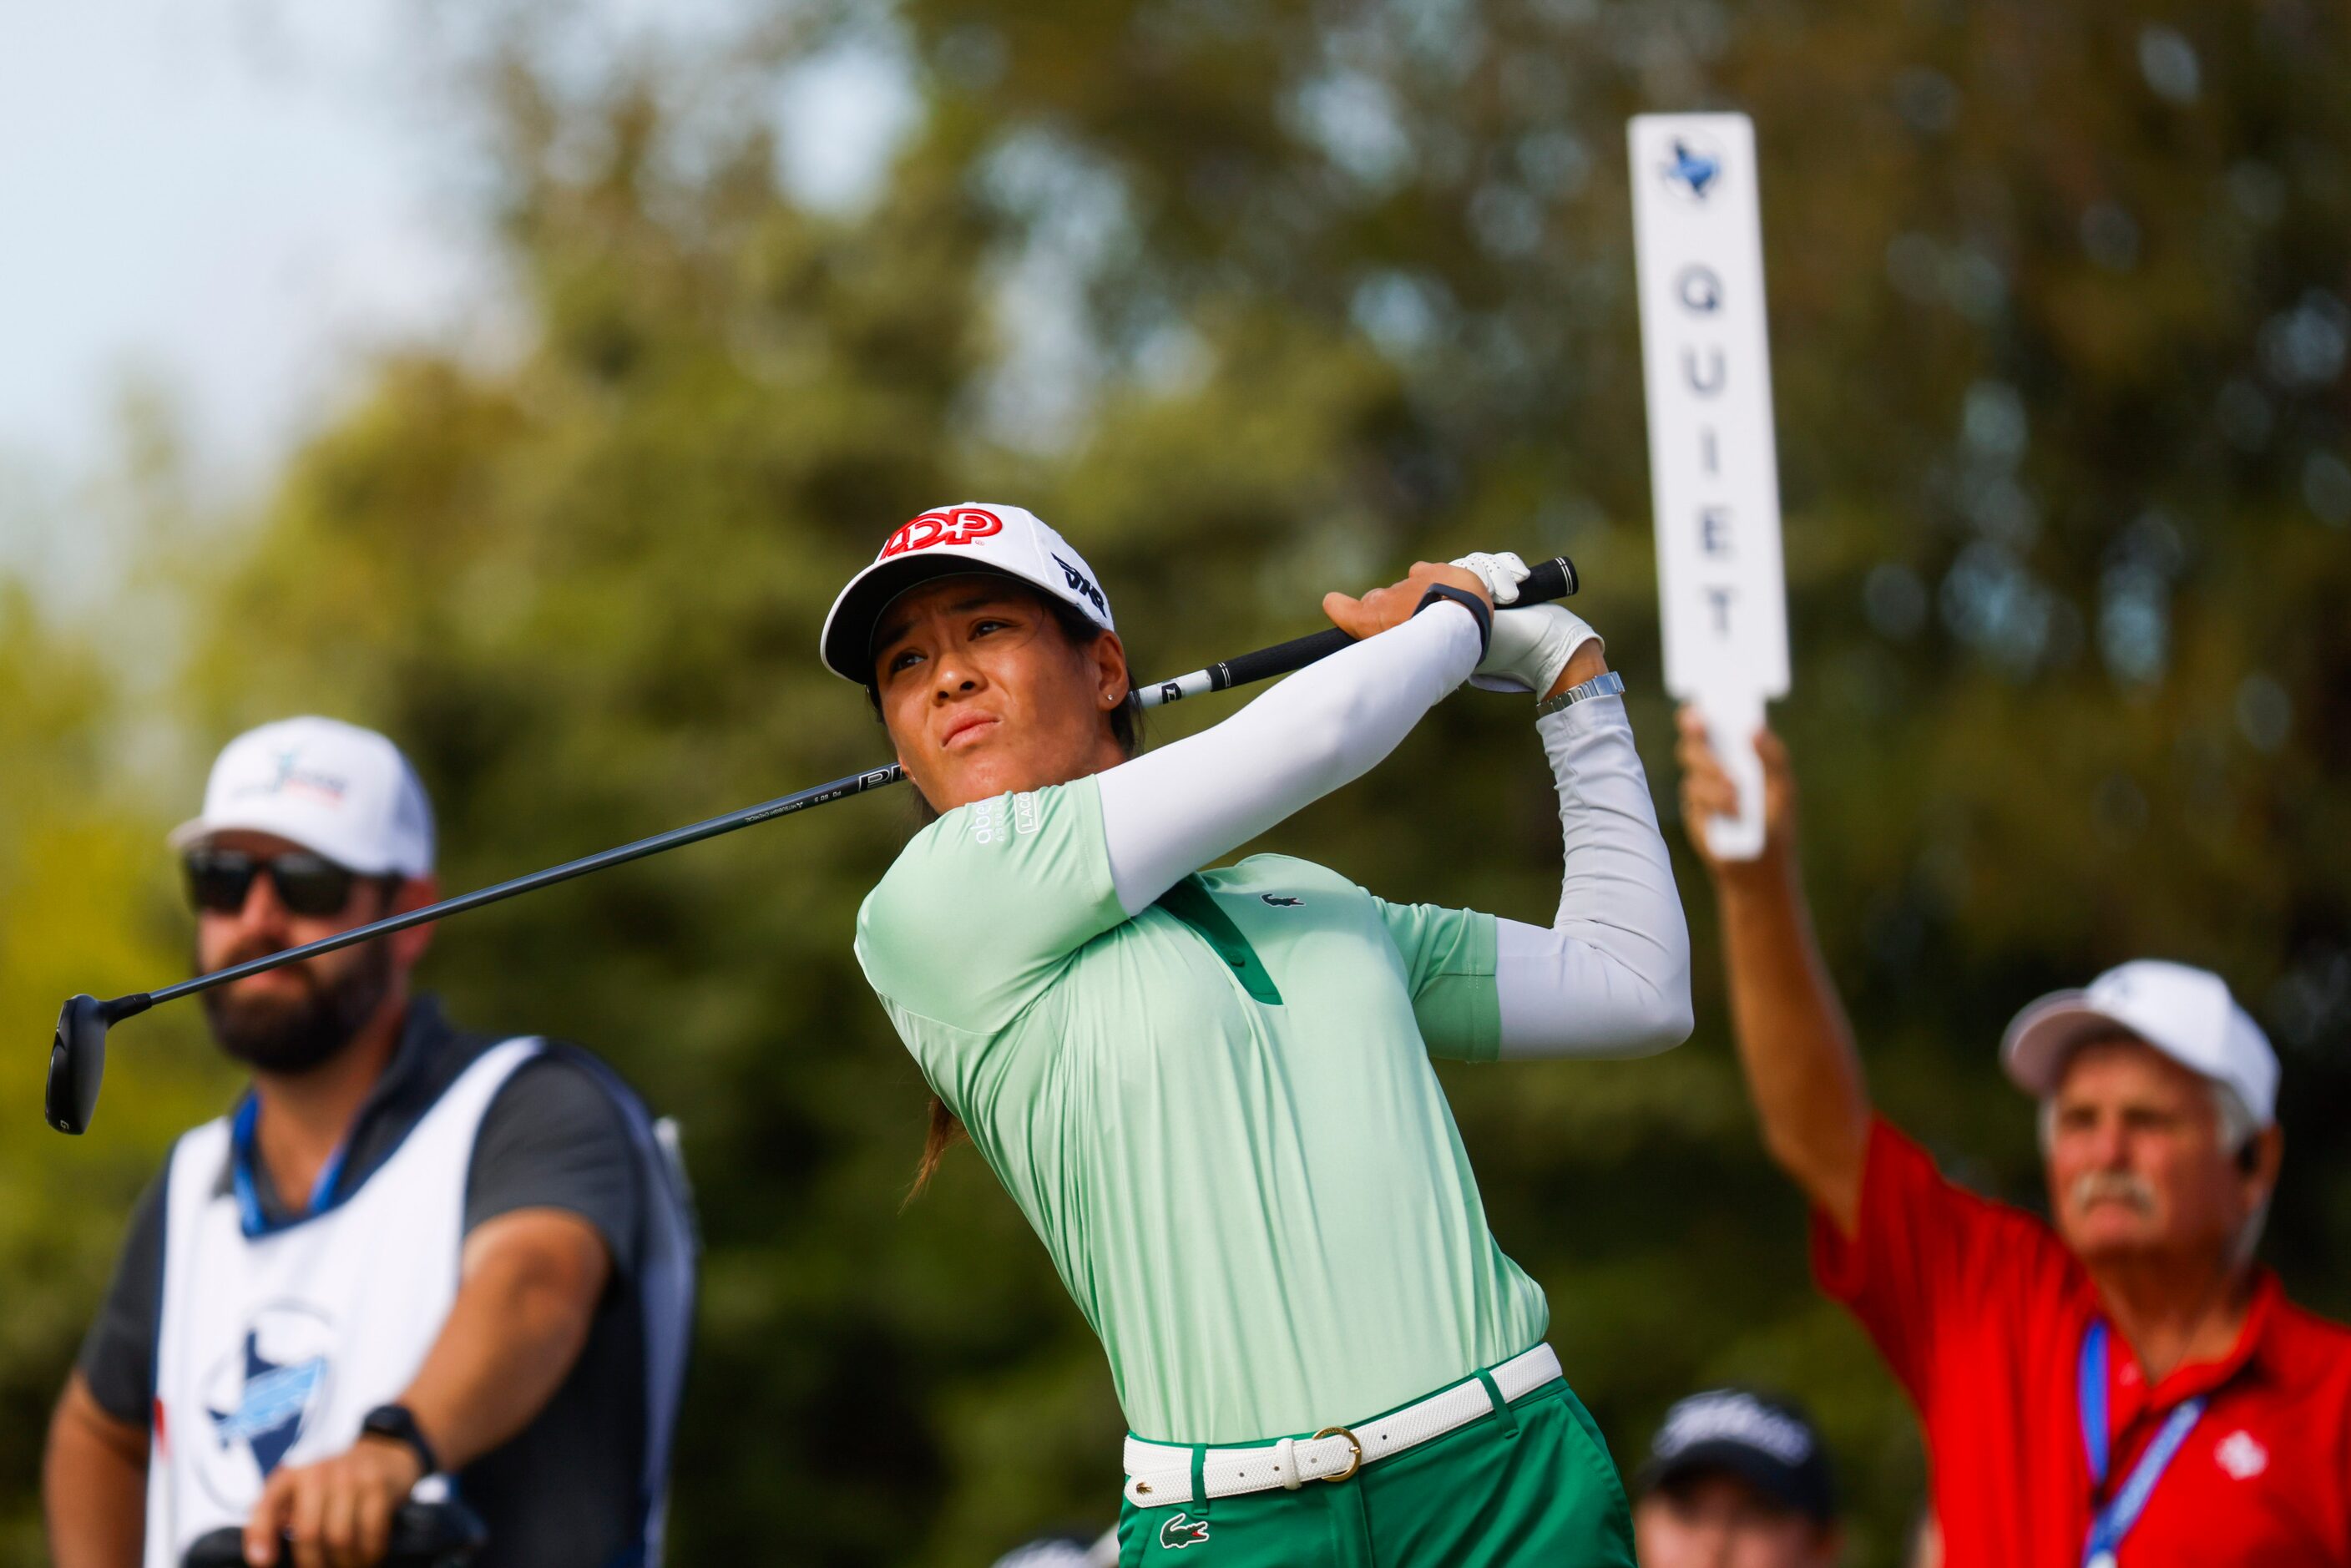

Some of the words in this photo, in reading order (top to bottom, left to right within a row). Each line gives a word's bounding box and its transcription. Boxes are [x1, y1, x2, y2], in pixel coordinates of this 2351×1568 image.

[1675, 264, 1736, 638] QUIET
[746, 812, 769, 822] CHEMICAL
[770, 804, 796, 816] MITSUBISHI
[1019, 792, 1033, 828] LACO
